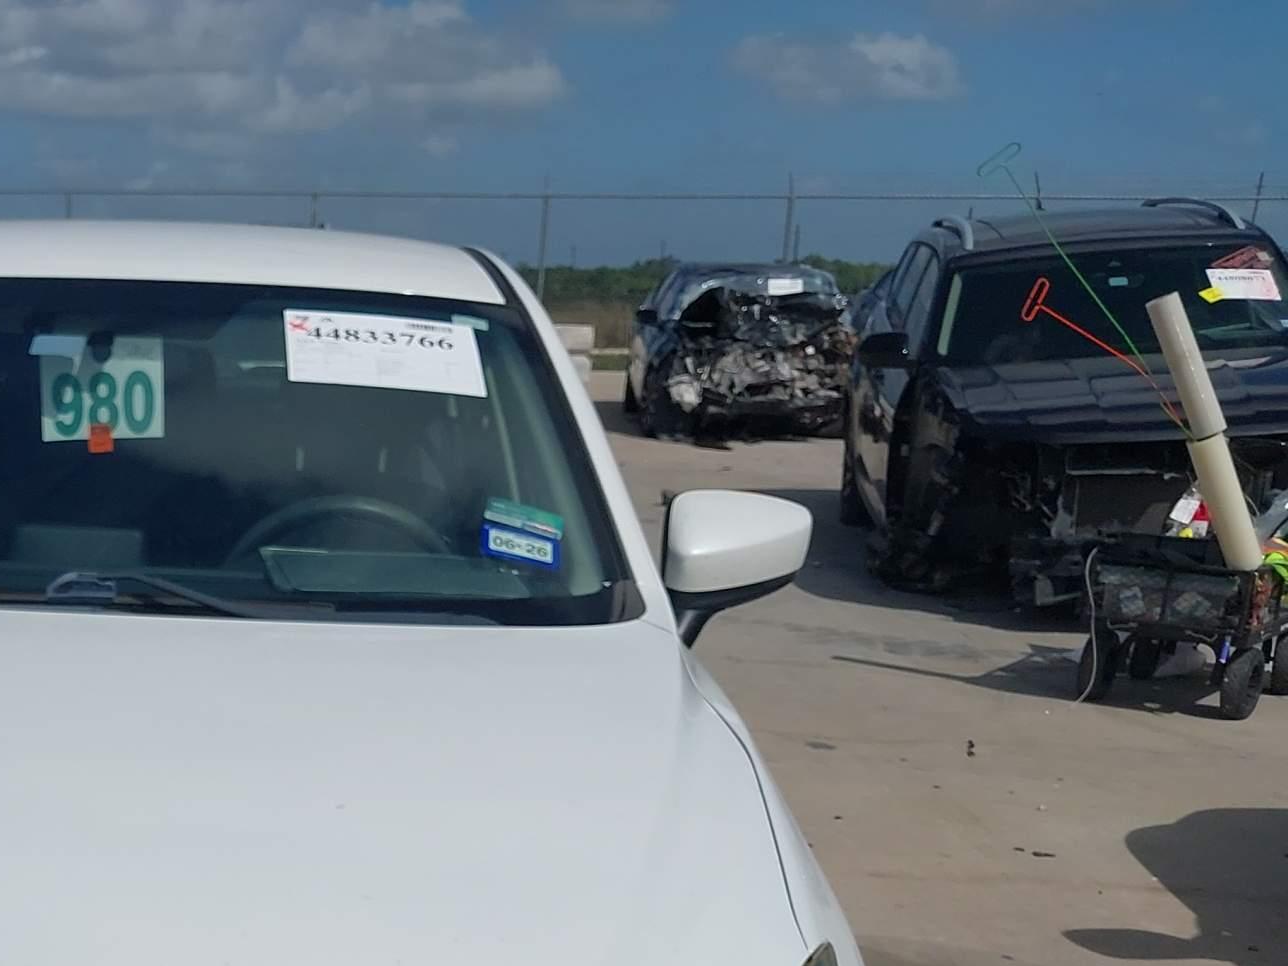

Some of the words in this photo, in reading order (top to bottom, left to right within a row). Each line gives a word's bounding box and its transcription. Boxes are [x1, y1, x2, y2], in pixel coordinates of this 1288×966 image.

[306, 326, 454, 351] 44833766
[52, 370, 154, 437] 980
[493, 536, 548, 558] 06-26
